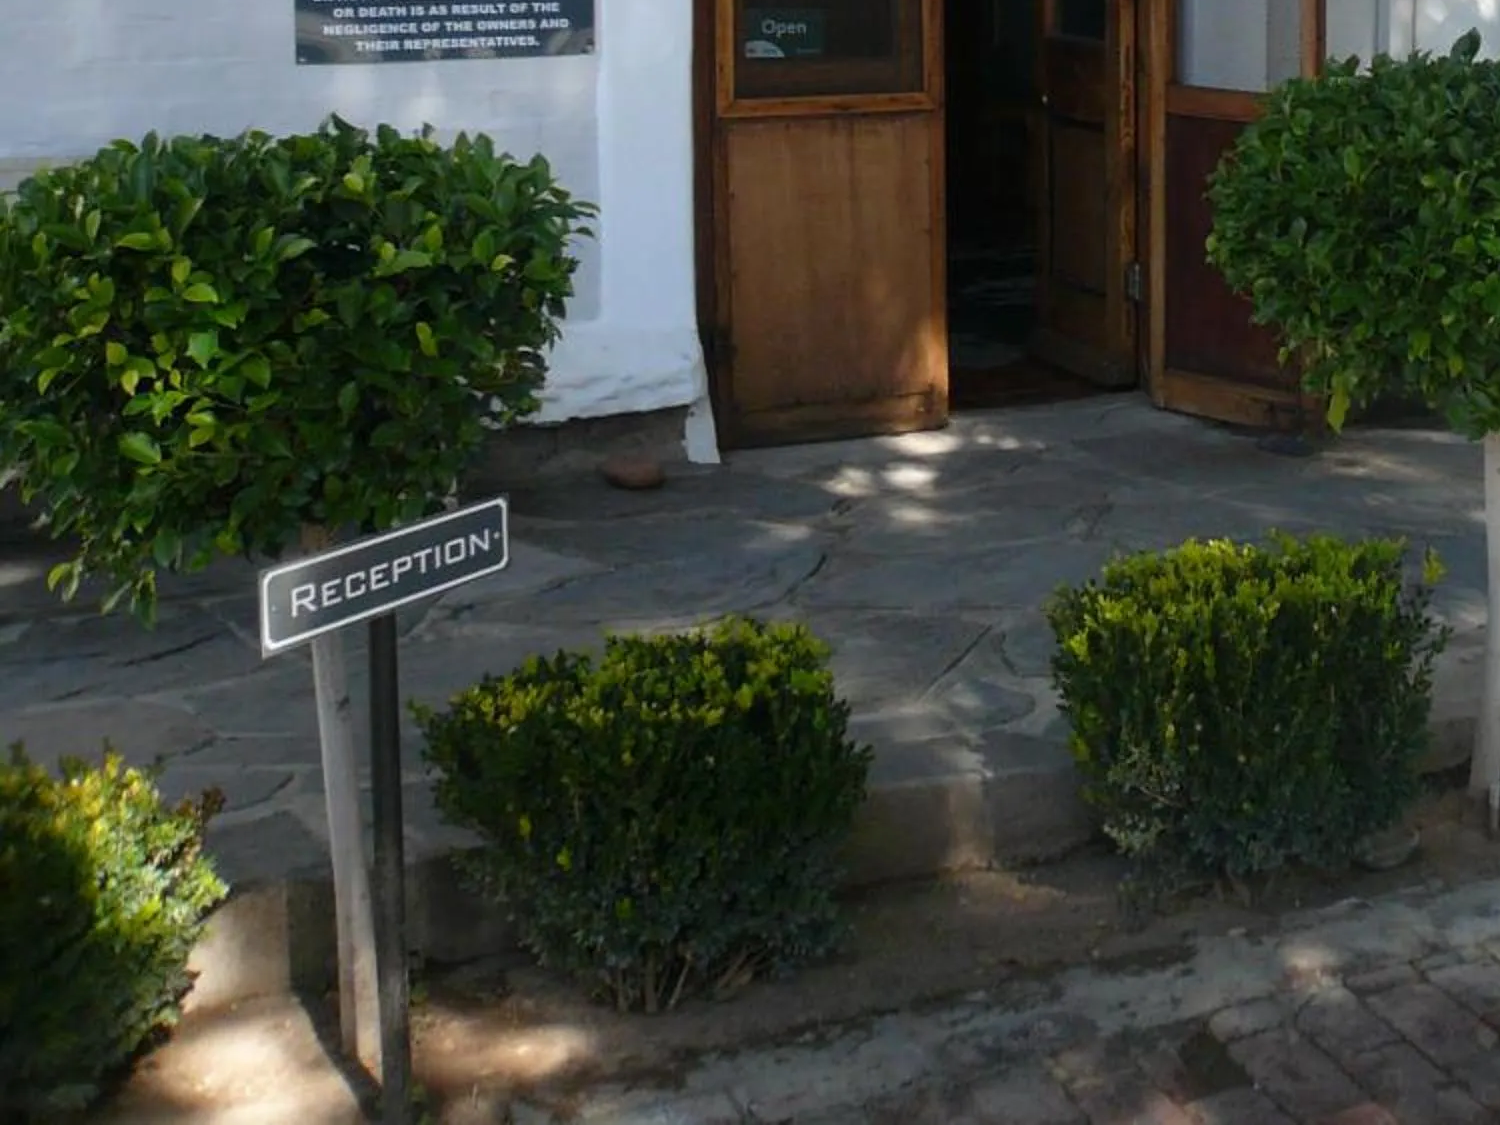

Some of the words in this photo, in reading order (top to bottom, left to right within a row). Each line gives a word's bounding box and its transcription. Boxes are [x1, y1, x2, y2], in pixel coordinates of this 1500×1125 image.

[333, 7, 355, 18] OR
[358, 6, 407, 18] DEATH
[411, 6, 425, 17] IS
[428, 4, 448, 16] AS
[451, 3, 506, 15] RESULT
[509, 2, 528, 14] OF
[531, 2, 560, 13] THE
[323, 22, 418, 36] NEGLIGENCE
[421, 21, 440, 33] OF
[443, 20, 473, 32] THE
[476, 18, 536, 31] OWNERS
[539, 18, 569, 29] AND
[761, 19, 807, 40] Open
[354, 39, 400, 52] THEIR
[291, 527, 490, 618] RECEPTION
